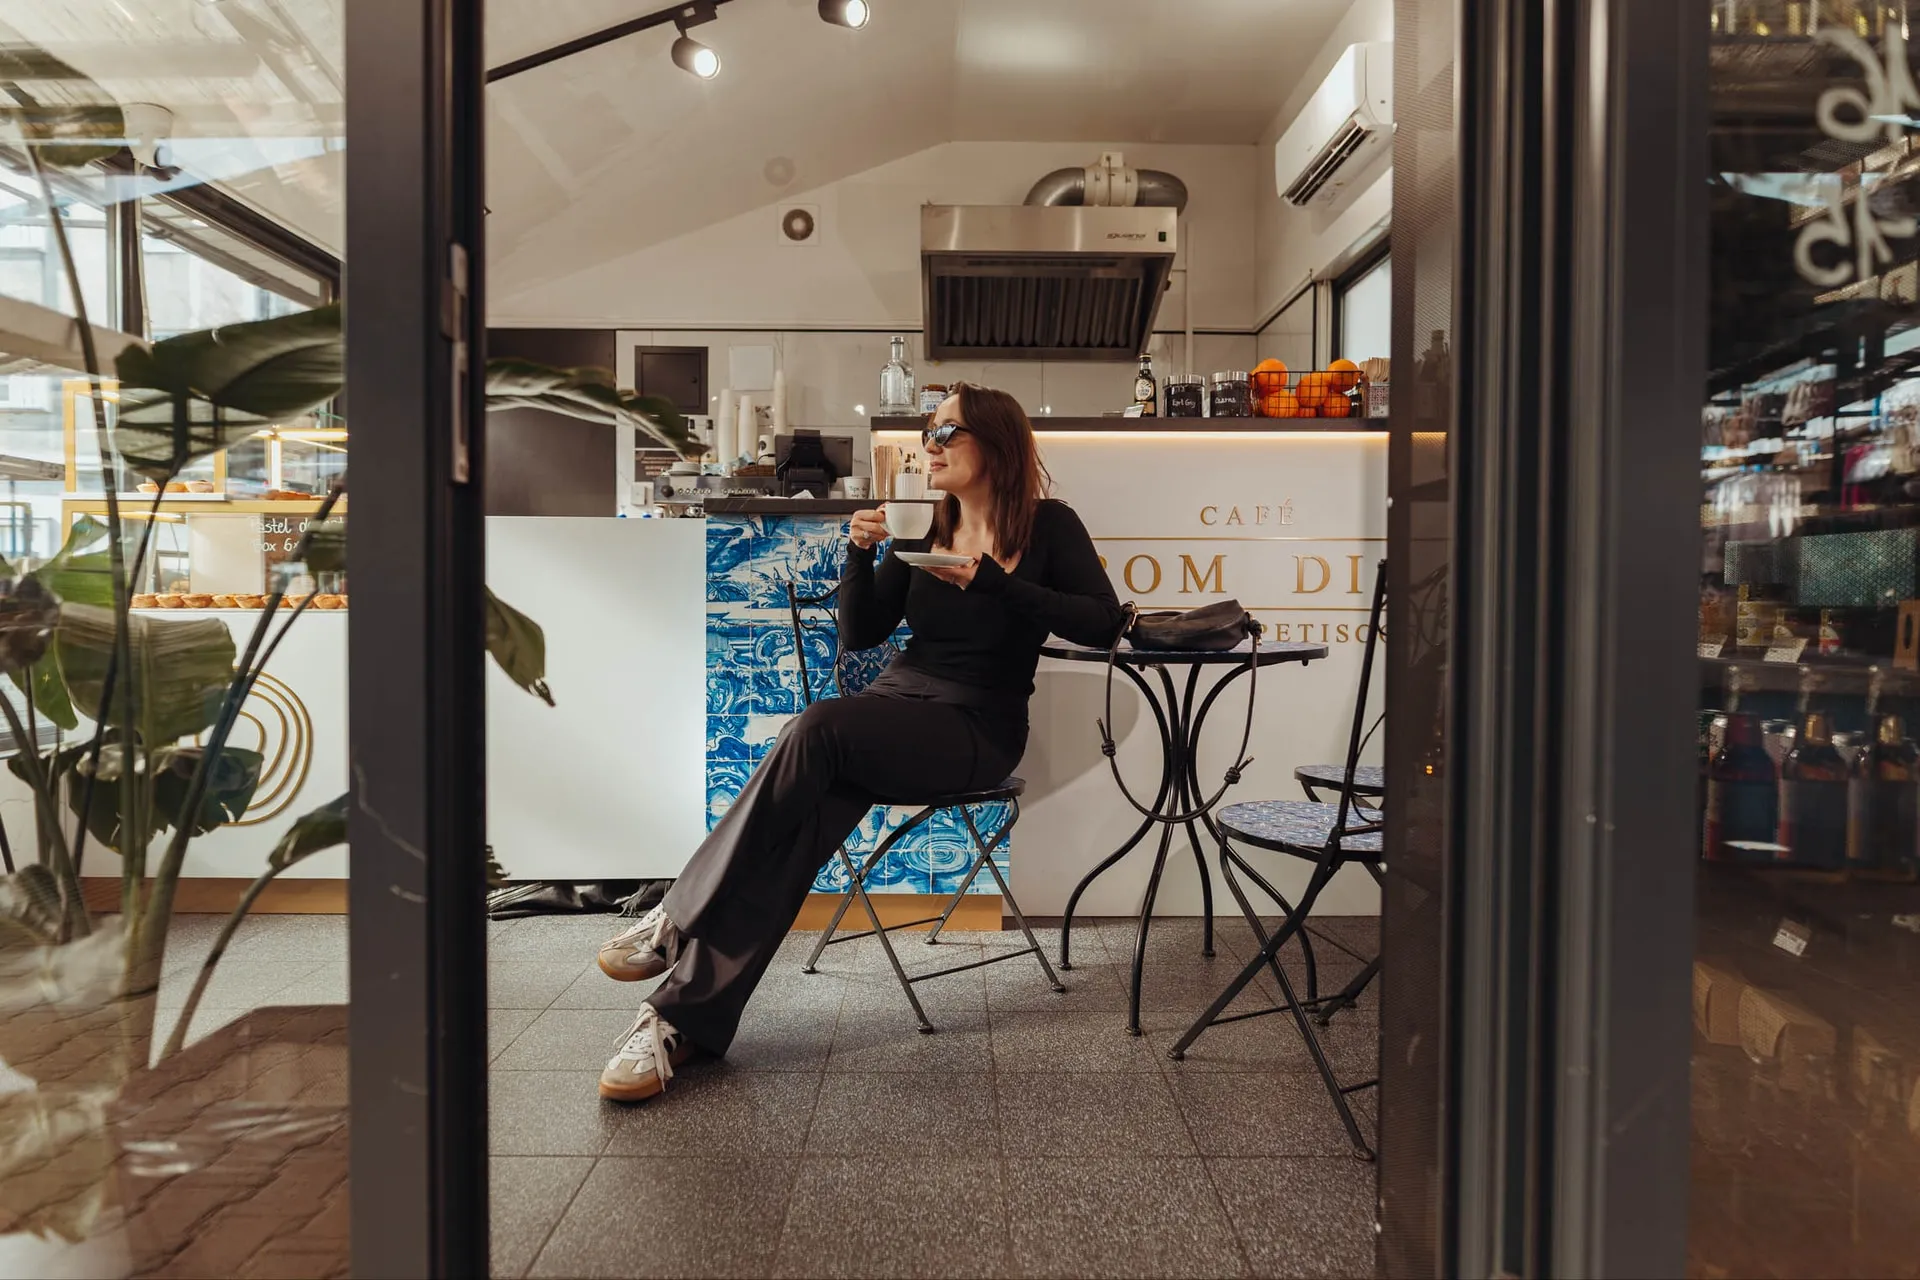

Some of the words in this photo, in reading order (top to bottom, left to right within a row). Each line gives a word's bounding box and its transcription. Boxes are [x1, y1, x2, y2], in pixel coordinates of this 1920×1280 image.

[1200, 497, 1294, 526] CAFÉ
[252, 517, 292, 534] astel
[254, 539, 277, 552] ox
[1098, 554, 1228, 595] OM
[1260, 623, 1387, 644] ETISC
